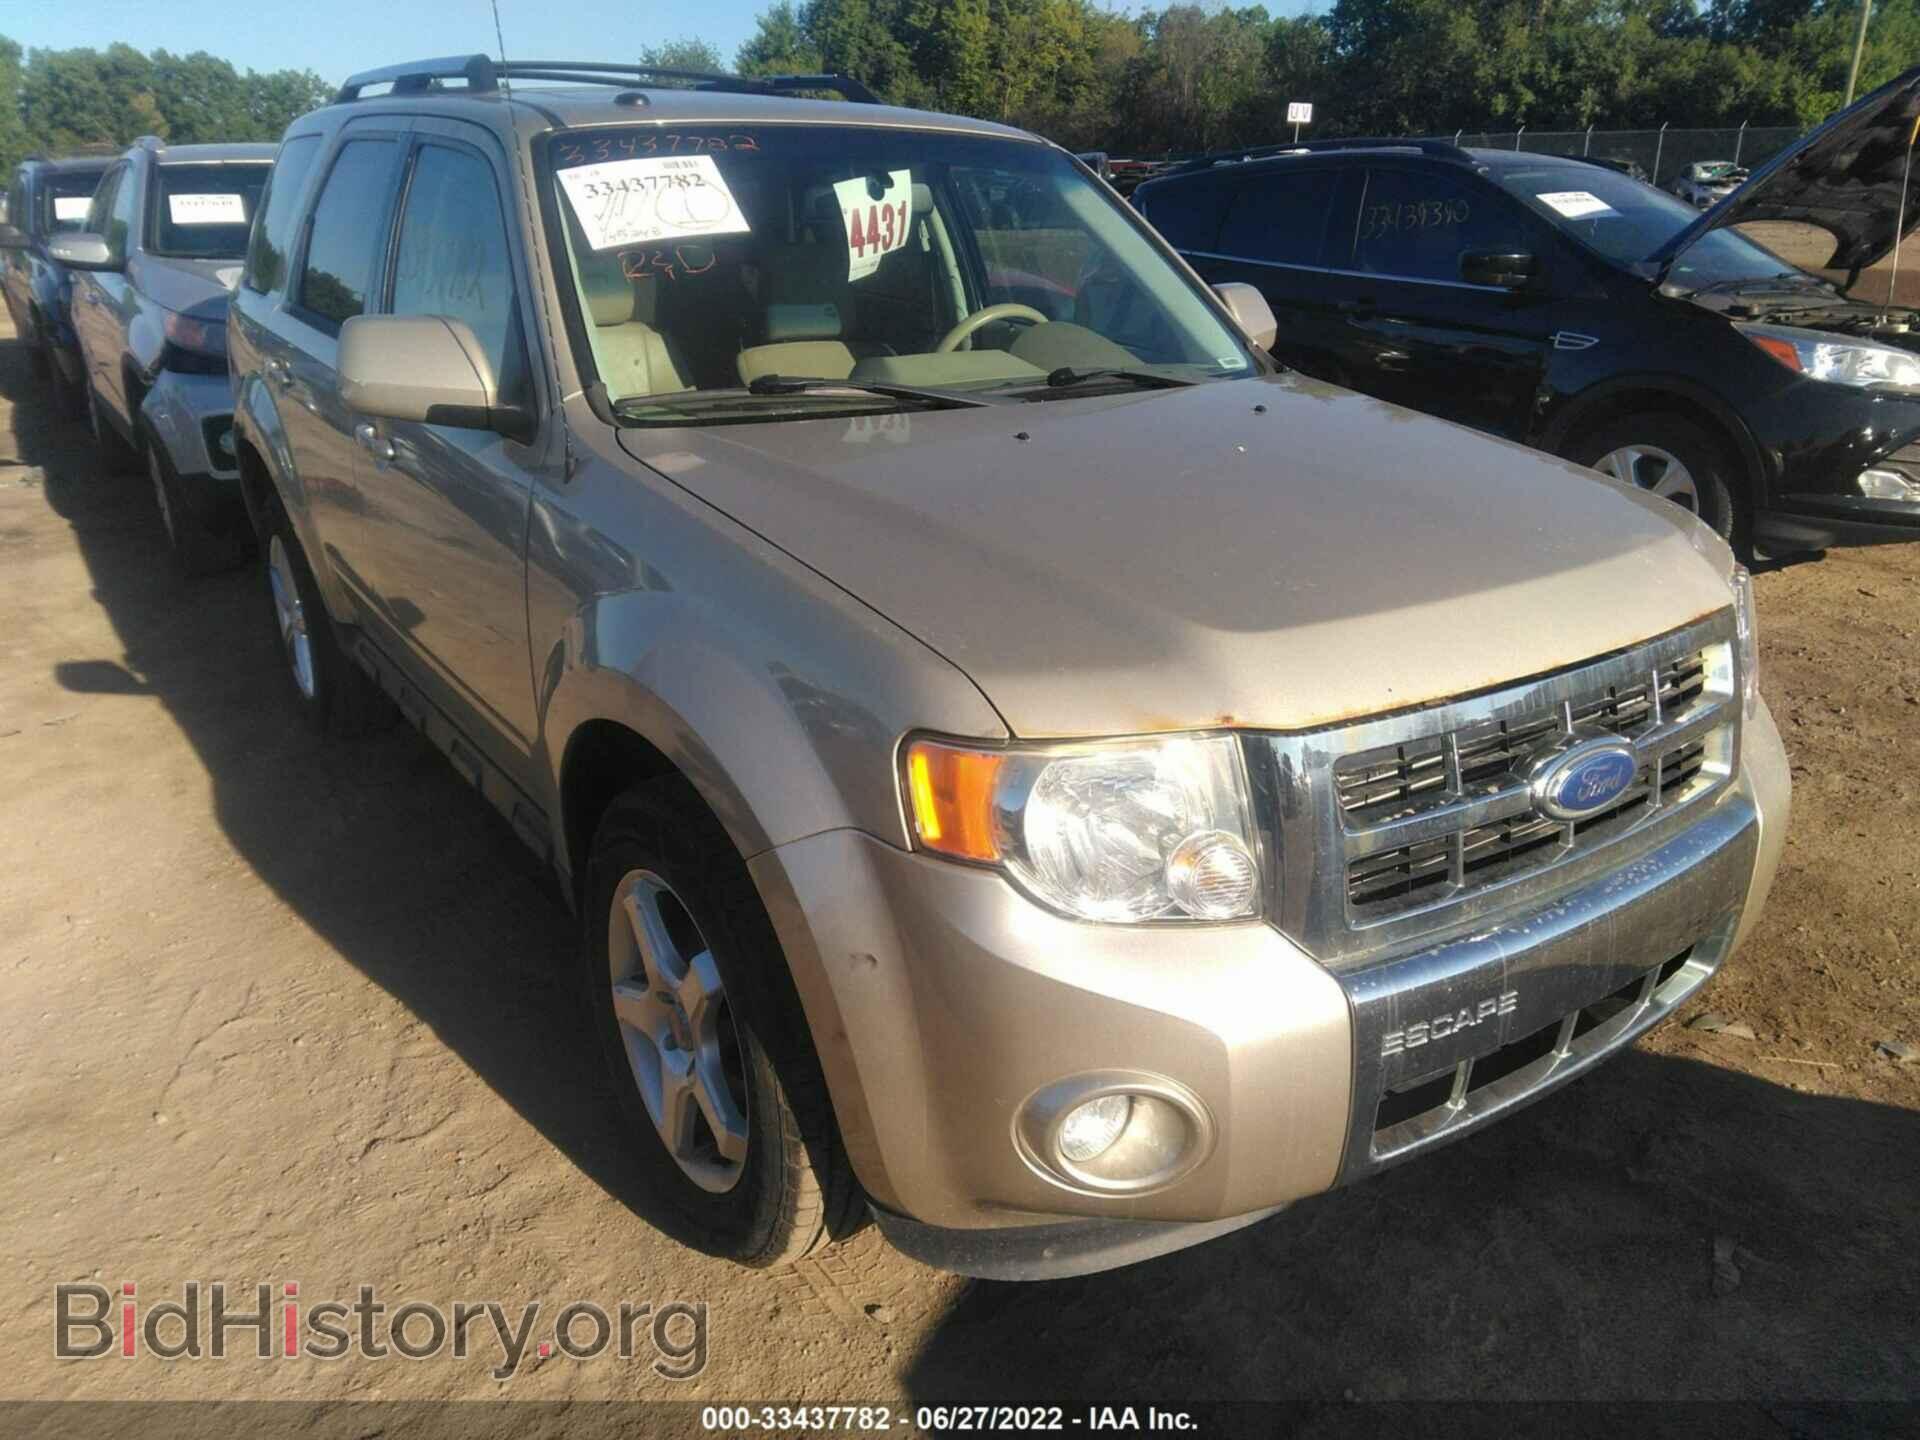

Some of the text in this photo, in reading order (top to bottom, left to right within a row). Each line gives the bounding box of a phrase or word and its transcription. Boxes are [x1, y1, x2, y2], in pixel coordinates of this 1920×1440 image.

[560, 135, 761, 162] 33437782
[584, 173, 705, 199] 33437782
[850, 200, 907, 258] 4431
[1577, 765, 1623, 802] Ford
[1381, 990, 1519, 1057] ESCAPE
